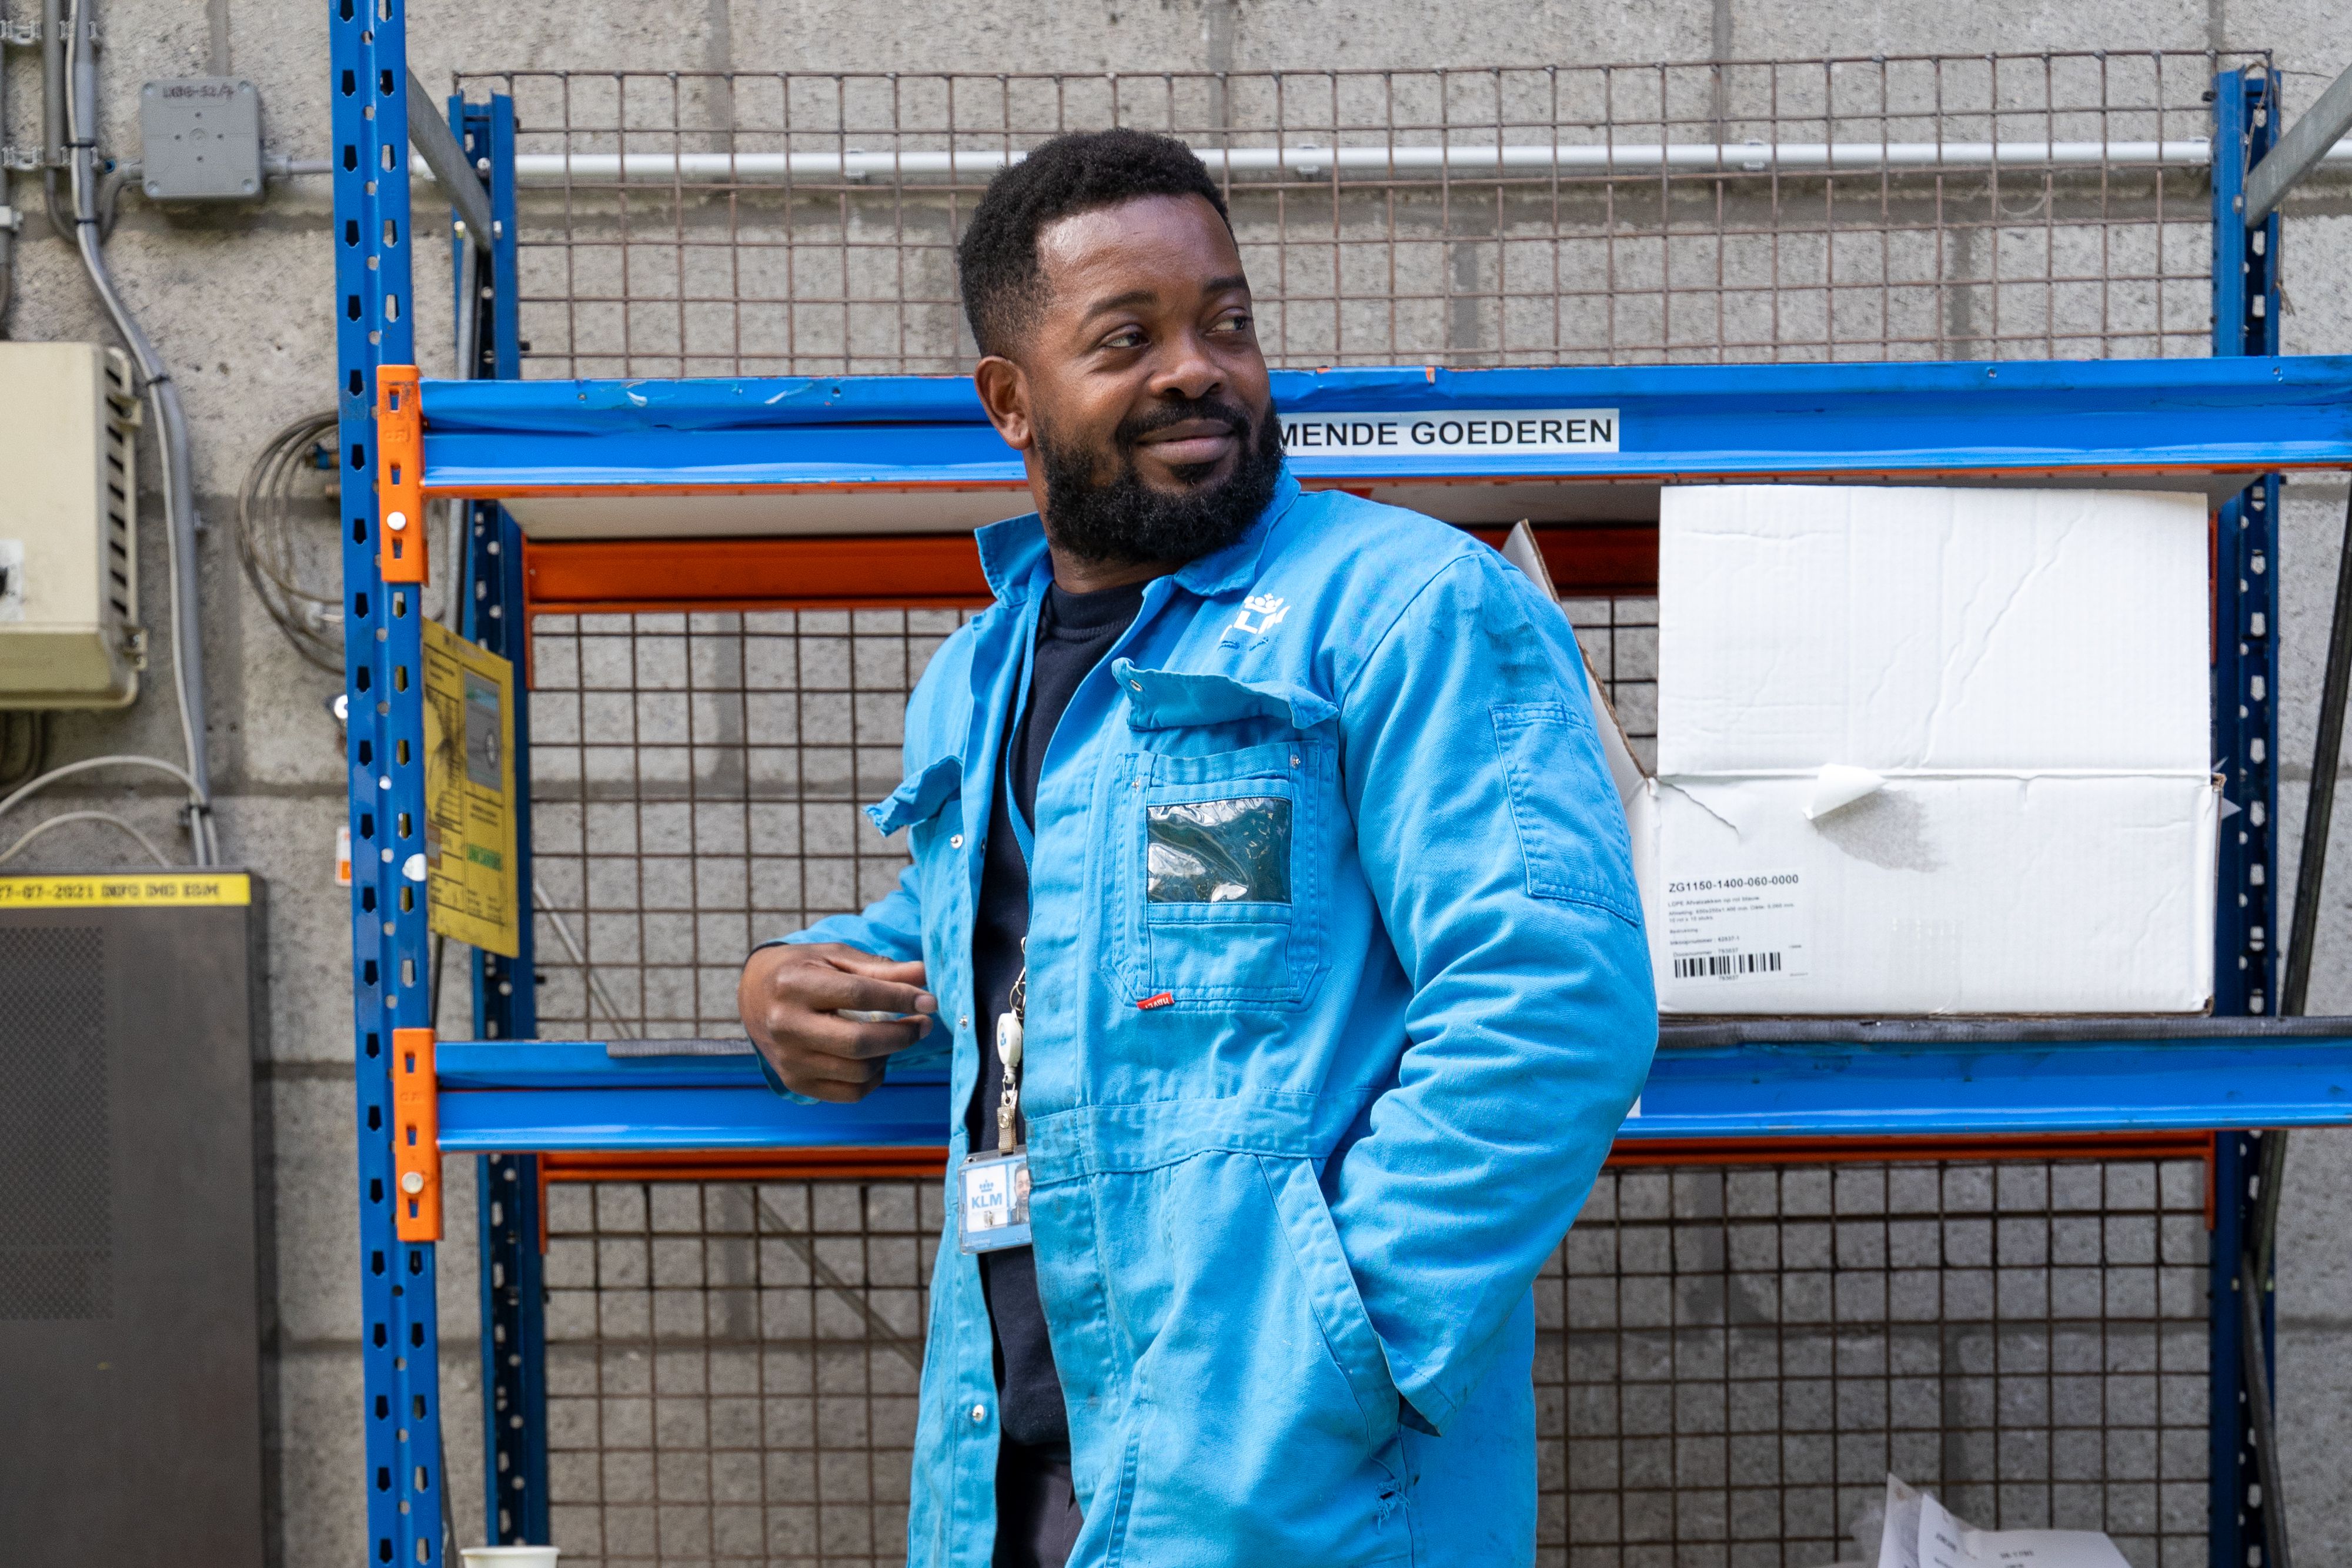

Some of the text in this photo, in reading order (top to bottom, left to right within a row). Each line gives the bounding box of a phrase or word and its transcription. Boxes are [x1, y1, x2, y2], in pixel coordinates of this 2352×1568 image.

[1280, 419, 1612, 446] MENDE GOEDEREN
[1669, 874, 1799, 893] ZG1150-1400-060-0000
[971, 1192, 1003, 1209] KLM
